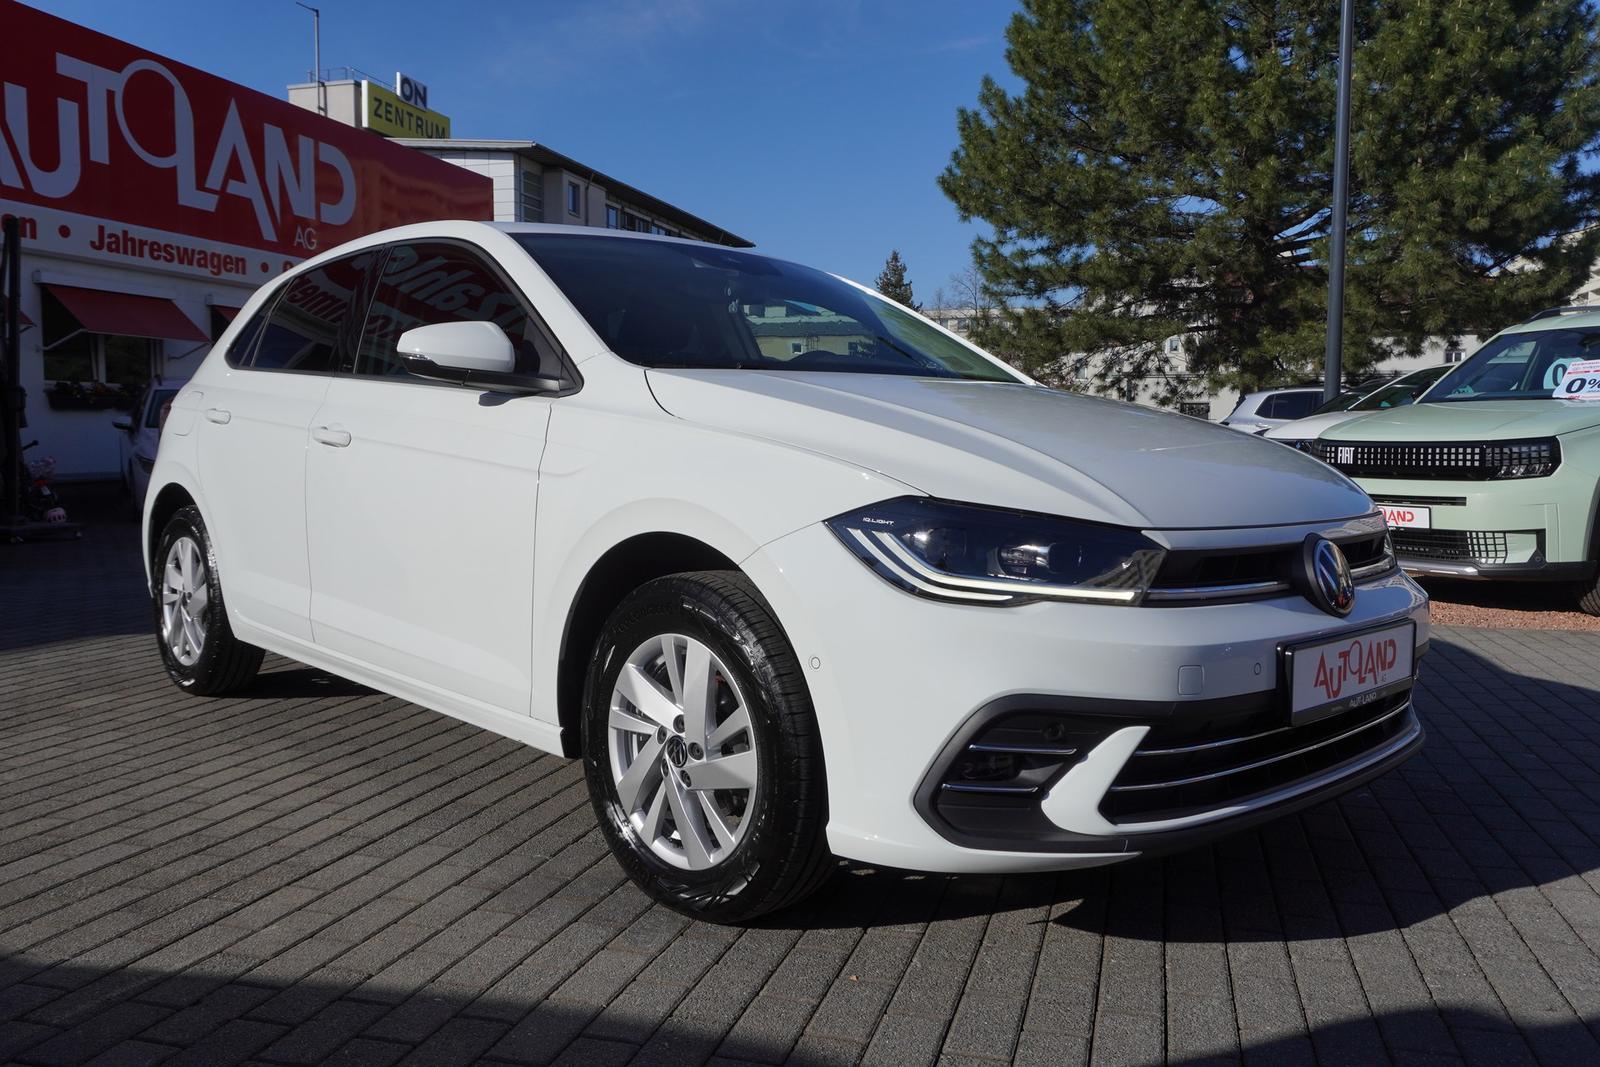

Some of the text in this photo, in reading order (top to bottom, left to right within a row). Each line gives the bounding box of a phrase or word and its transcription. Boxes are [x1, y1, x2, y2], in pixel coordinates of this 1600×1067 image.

[373, 96, 446, 139] ZENTRUM
[90, 224, 247, 276] Jahreswagen
[294, 227, 318, 250] AG
[1337, 446, 1355, 464] FIAT
[1313, 638, 1397, 699] AUTOLAND
